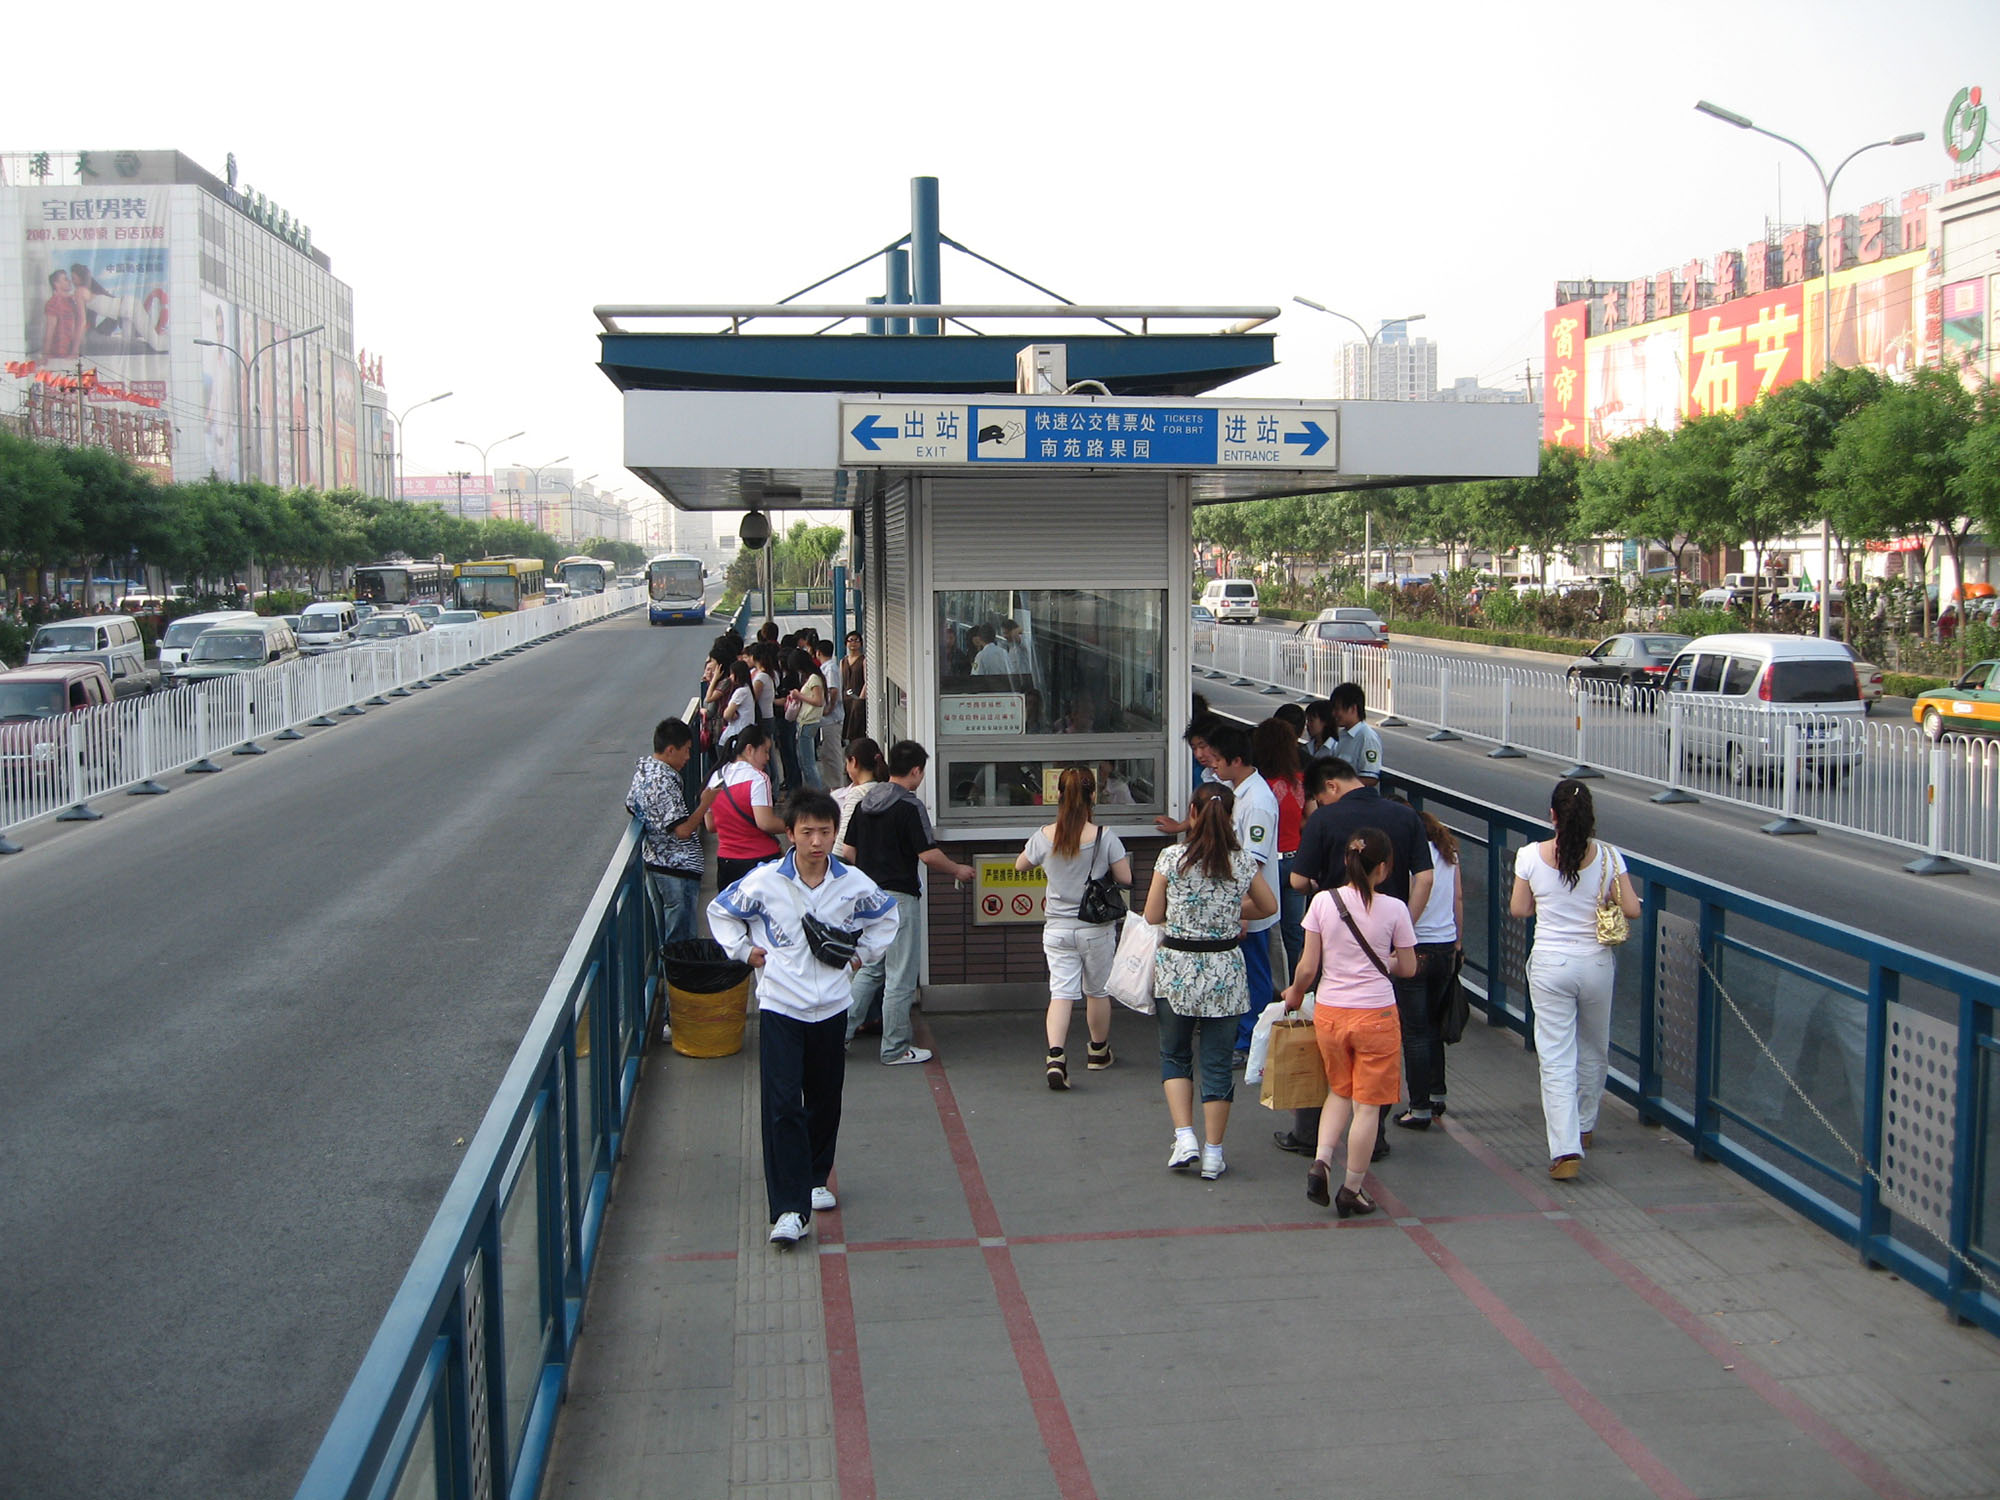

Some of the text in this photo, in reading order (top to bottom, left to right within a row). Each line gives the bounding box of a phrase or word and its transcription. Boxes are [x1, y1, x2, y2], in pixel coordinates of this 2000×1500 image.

[42, 198, 147, 221] 宝威男装
[1691, 303, 1800, 414] 布艺
[904, 410, 960, 440] 出站
[1035, 411, 1156, 432] 快速公交售票处
[1163, 414, 1204, 424] TICKETS
[1224, 414, 1280, 444] 进站
[1163, 425, 1204, 435] FOR BRT
[916, 446, 947, 458] EXIT
[1040, 438, 1150, 459] 南苑路果园
[1223, 450, 1280, 462] ENTRANCE
